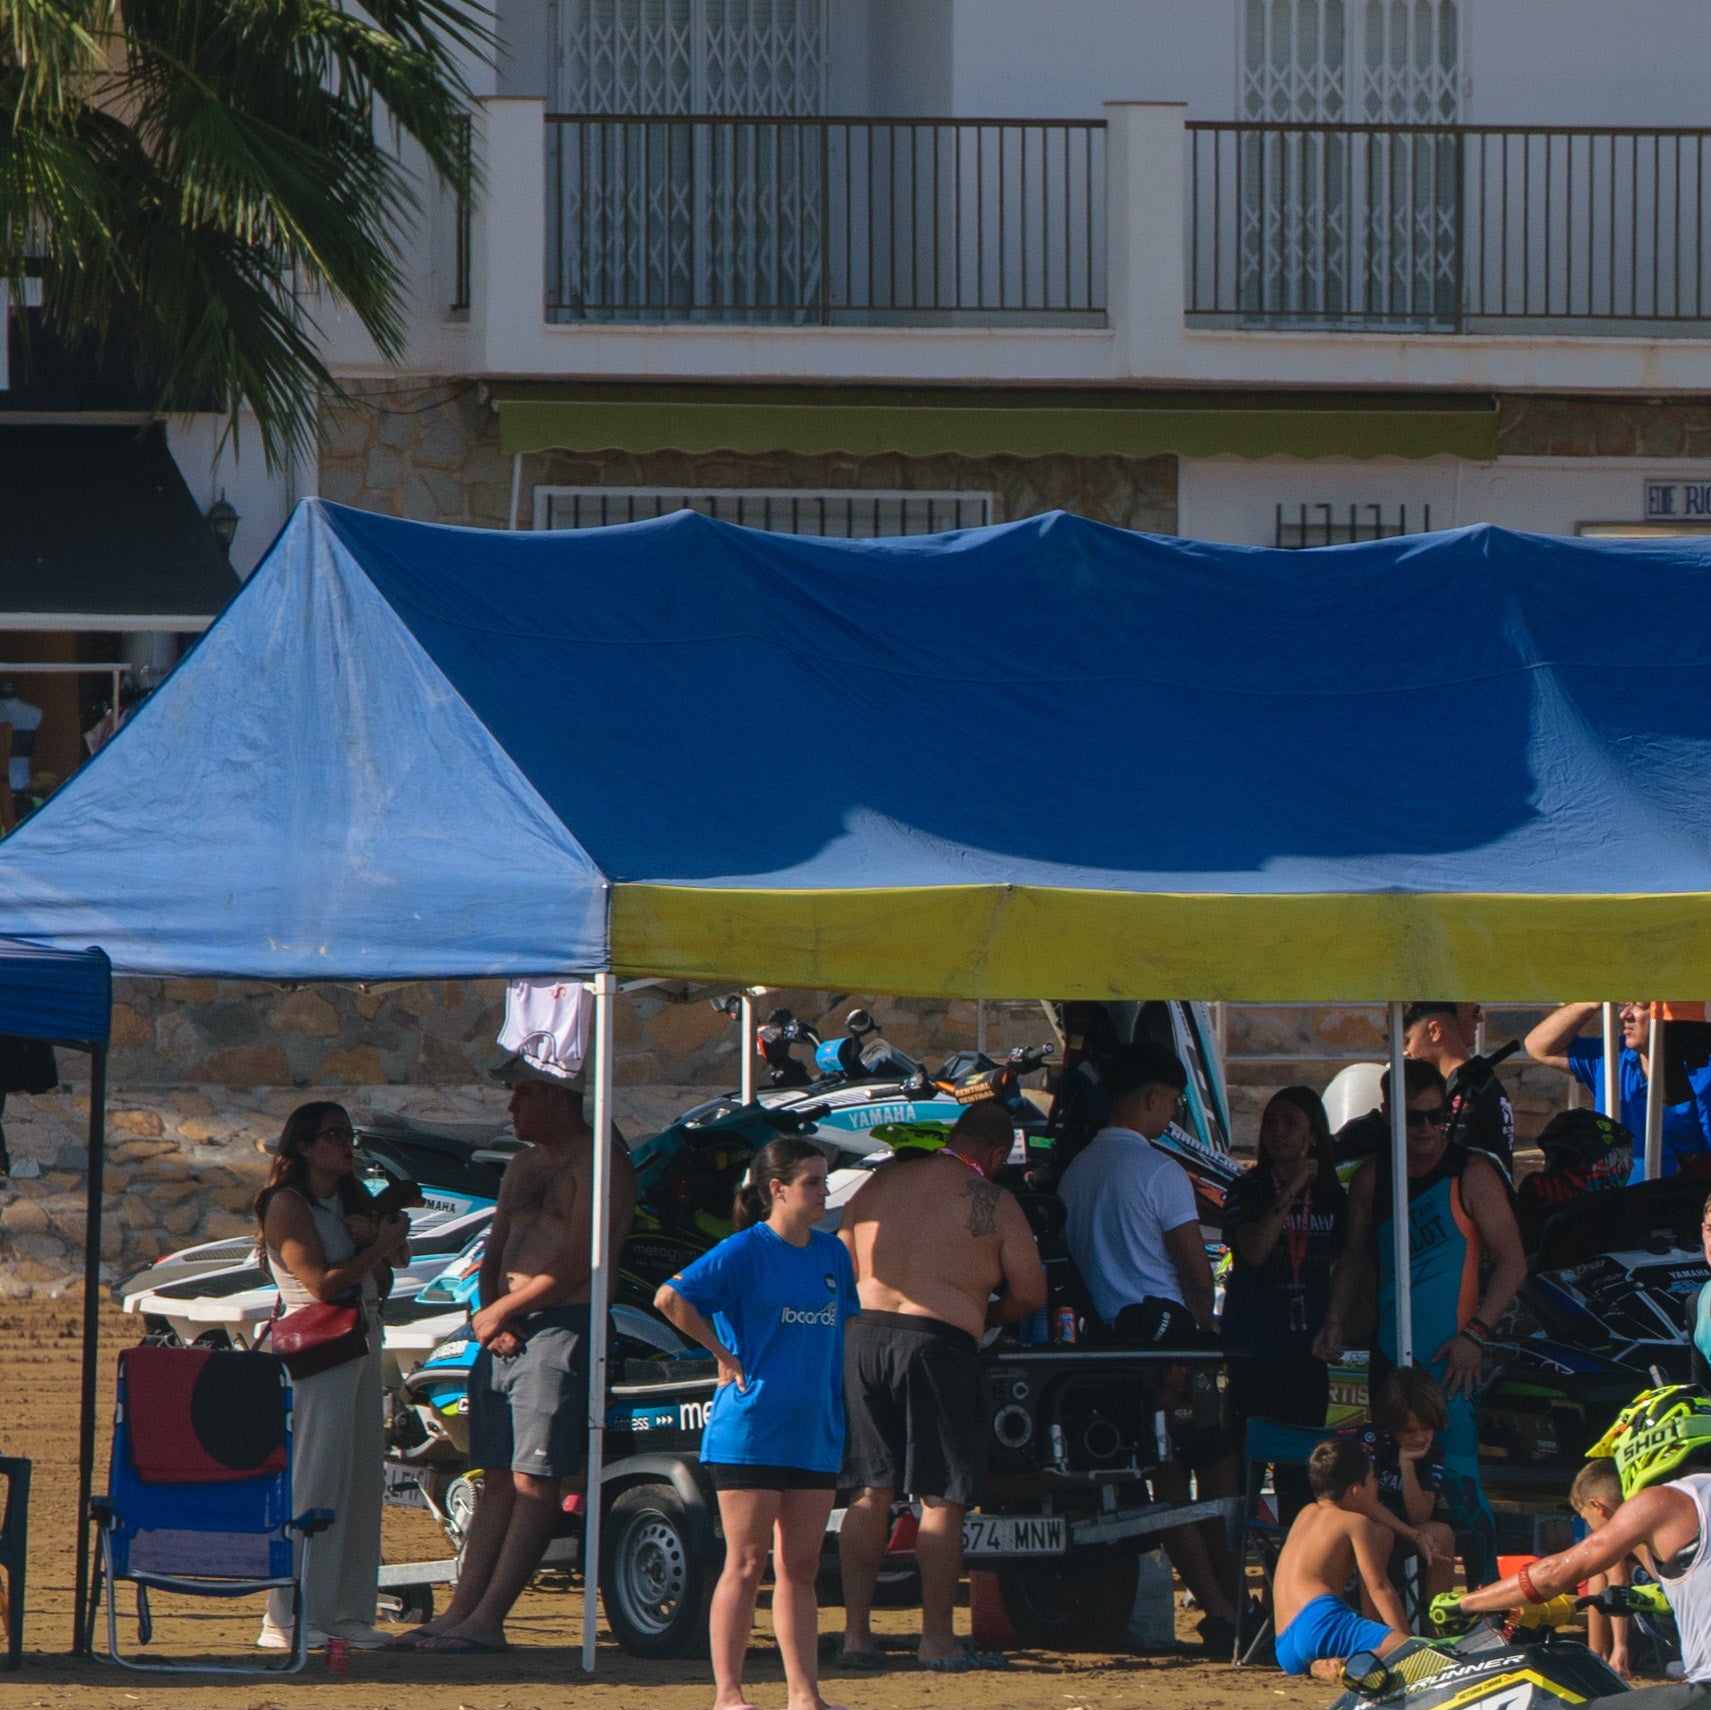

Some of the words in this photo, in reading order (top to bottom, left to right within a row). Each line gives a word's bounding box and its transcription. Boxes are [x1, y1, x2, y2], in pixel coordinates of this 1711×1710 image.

[848, 1104, 917, 1129] YAMAHA
[1623, 1419, 1679, 1463] SHOT
[1014, 1520, 1062, 1549] MNW
